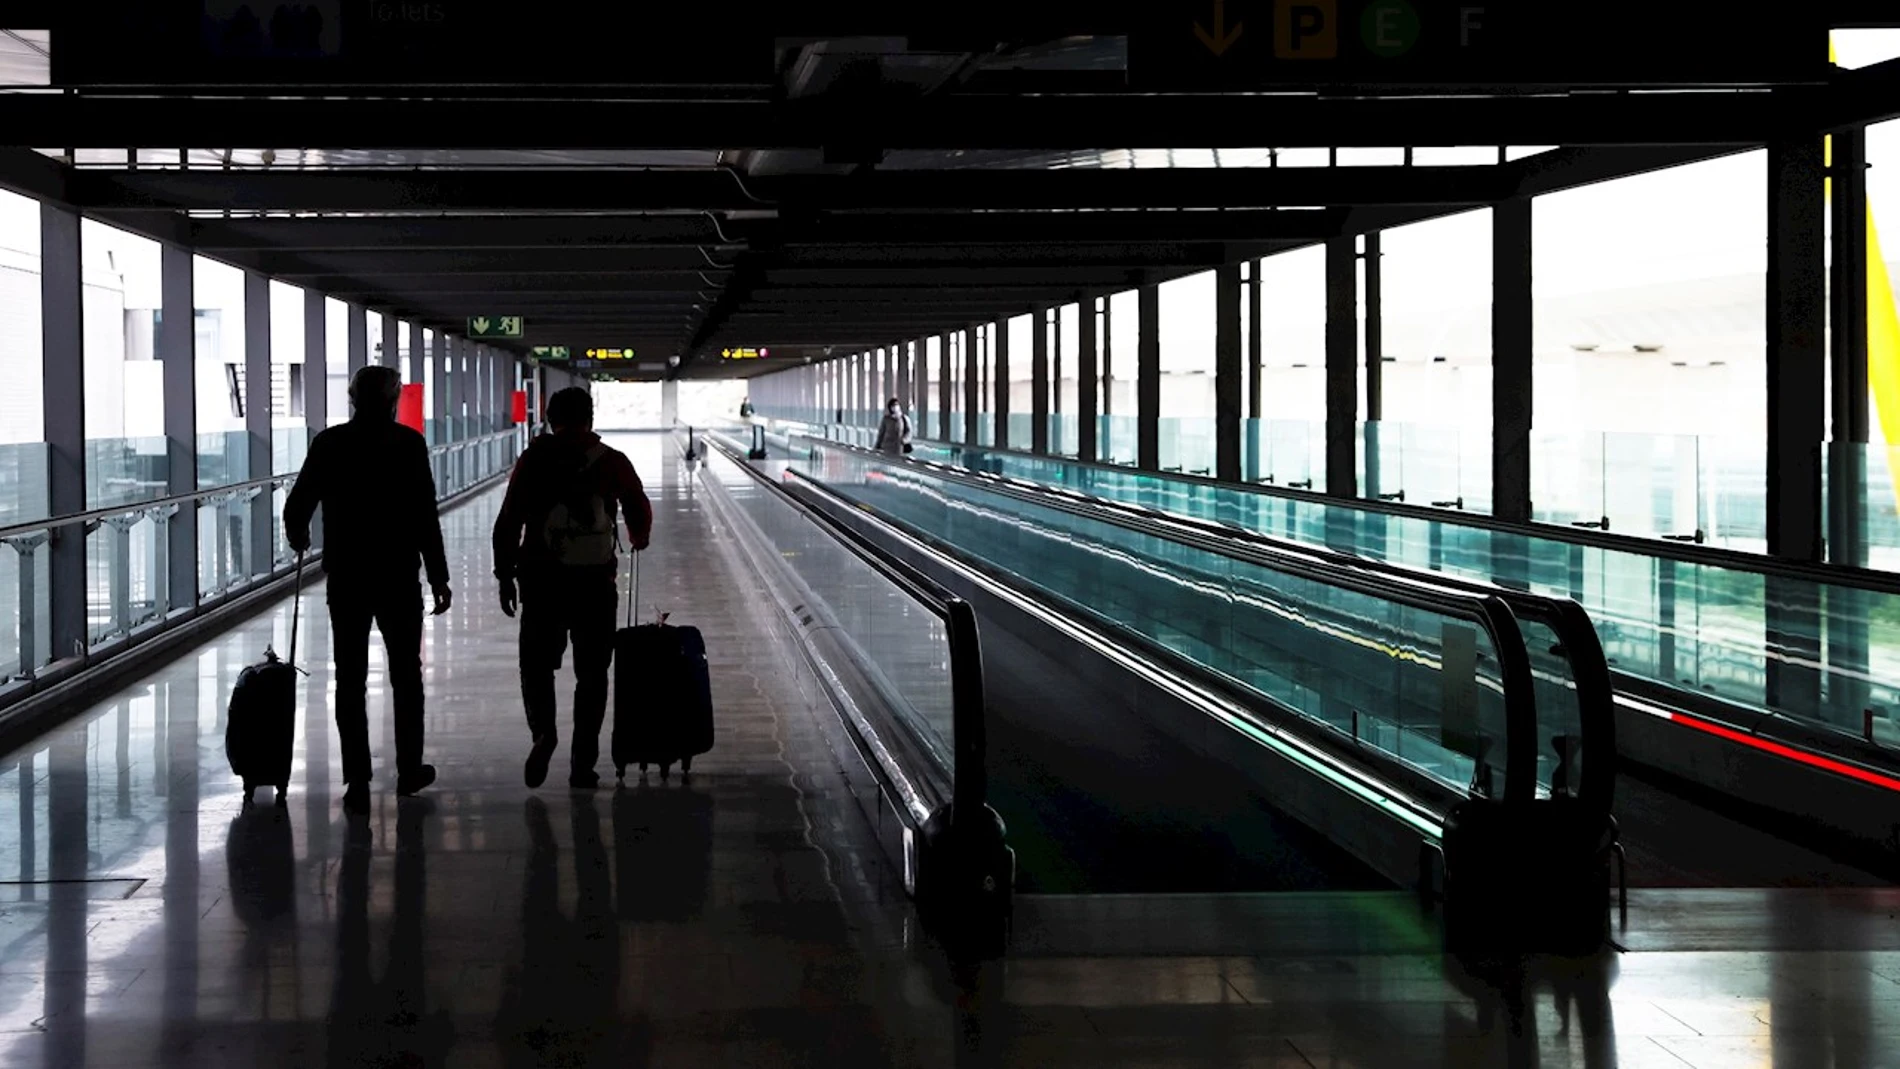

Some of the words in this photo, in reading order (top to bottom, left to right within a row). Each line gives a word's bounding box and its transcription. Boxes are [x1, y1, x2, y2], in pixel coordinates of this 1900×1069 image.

[1290, 6, 1325, 50] P
[1376, 8, 1403, 47] E
[1460, 7, 1485, 46] F
